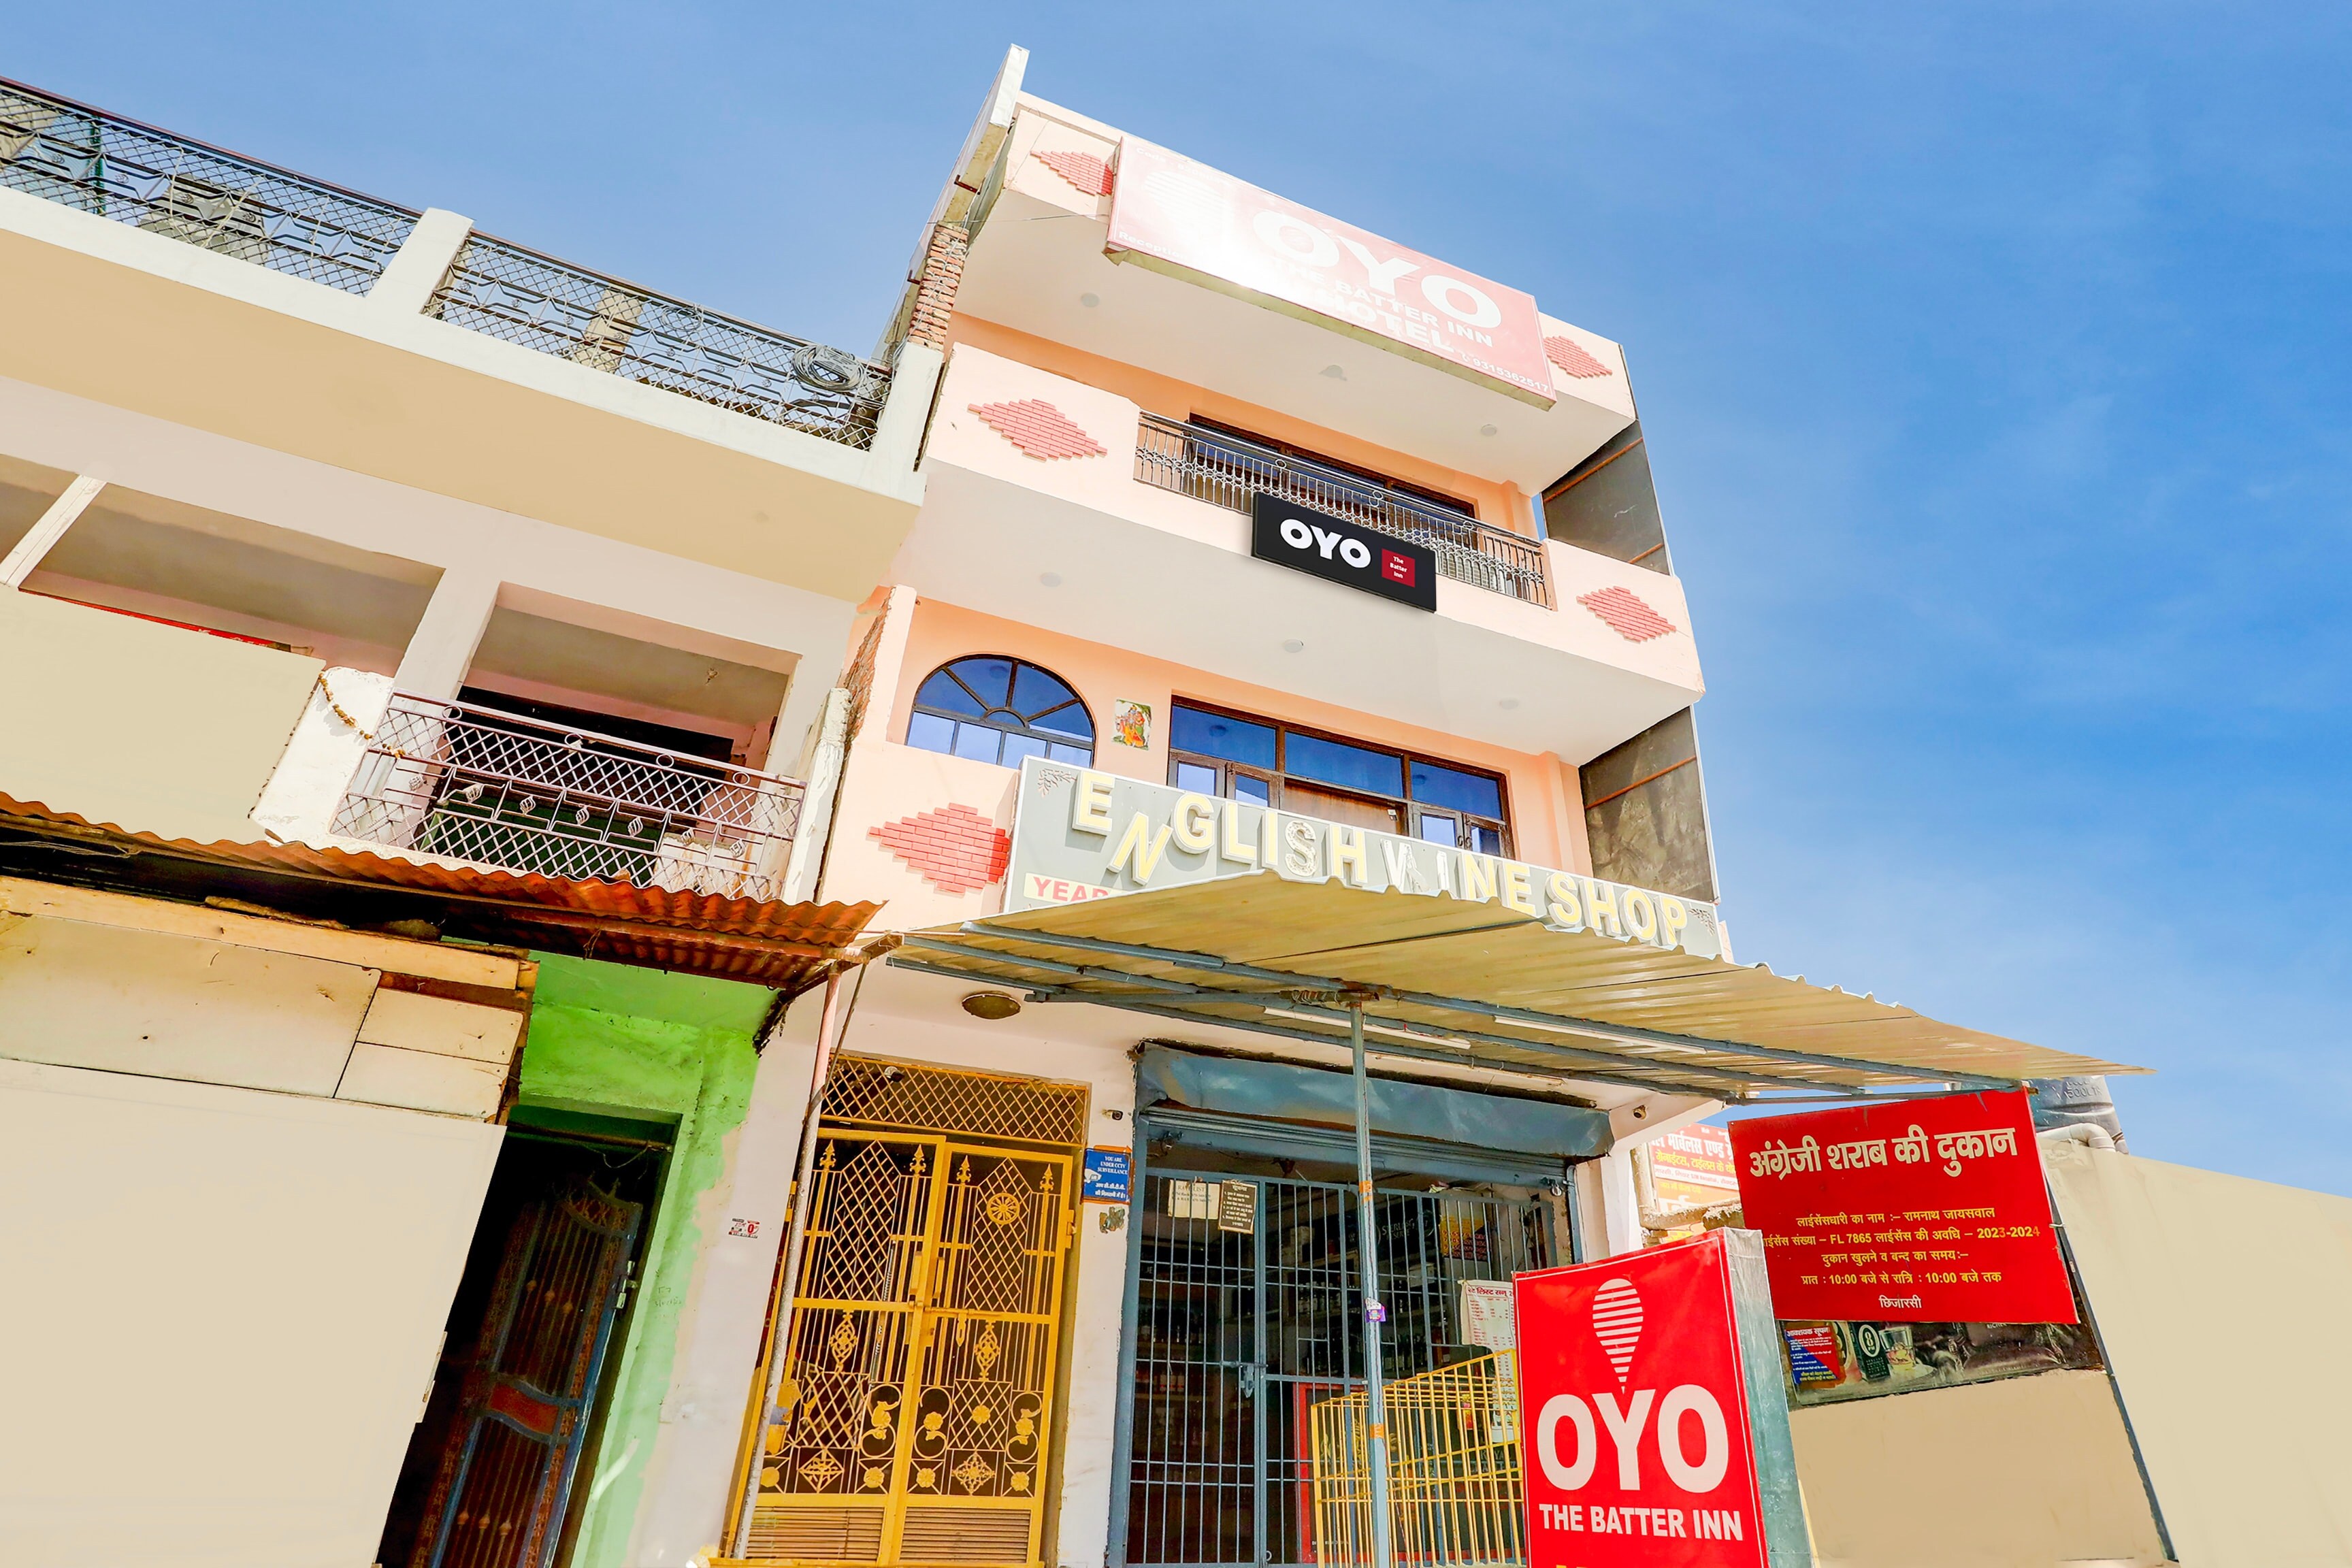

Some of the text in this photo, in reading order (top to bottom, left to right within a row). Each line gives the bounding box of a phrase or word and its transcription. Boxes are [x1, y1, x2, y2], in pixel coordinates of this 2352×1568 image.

[1252, 211, 1502, 329] OYO
[1335, 280, 1440, 328] BATTER
[1447, 320, 1494, 348] INN
[1472, 357, 1548, 393] 9315362517
[1280, 519, 1371, 568] OYO
[1390, 562, 1407, 572] Batter
[1392, 555, 1404, 564] The
[1072, 770, 1369, 885] ENGLISH
[1546, 872, 1687, 945] SHOP
[1749, 1135, 1822, 1180] अंग्रेजी
[1827, 1139, 1888, 1169] शराब
[1891, 1124, 1930, 1164] की
[1933, 1128, 2018, 1177] दुकान
[1097, 1166, 1128, 1175] SURVEILLANCE
[1796, 1211, 1848, 1228] लाईसेंसधारी
[1850, 1213, 1864, 1224] का
[1866, 1213, 1885, 1224] नाम
[1903, 1210, 1940, 1222] रामनाथ
[1942, 1207, 1995, 1219] जायसवाल
[1763, 1233, 1789, 1248] ाईसेंस
[1791, 1233, 1816, 1246] संख्या
[1830, 1234, 1844, 1245] FL
[1846, 1232, 1872, 1244] 7865
[1874, 1228, 1912, 1244] लाईसेंस
[1914, 1227, 1929, 1241] की
[1932, 1226, 1961, 1241] अवधि
[1976, 1226, 2041, 1239] 2023-2024
[1820, 1253, 1848, 1267] दुकान
[1850, 1249, 1878, 1267] खुलने
[1880, 1252, 1888, 1262] व
[1889, 1251, 1910, 1262] बन्द
[1912, 1251, 1927, 1261] का
[1801, 1275, 1818, 1285] प्रात
[1829, 1273, 1857, 1285] 10:00
[1859, 1271, 1877, 1284] बजे
[1879, 1270, 1889, 1284] से
[1891, 1270, 1913, 1284] रात्रि
[1925, 1272, 1957, 1284] 10:00
[1959, 1269, 1979, 1283] बजे
[1981, 1271, 2002, 1283] तक
[1878, 1294, 1922, 1309] छिजारसी
[1537, 1384, 1729, 1493] OYO
[1539, 1503, 1744, 1541] THE BATTER INN
